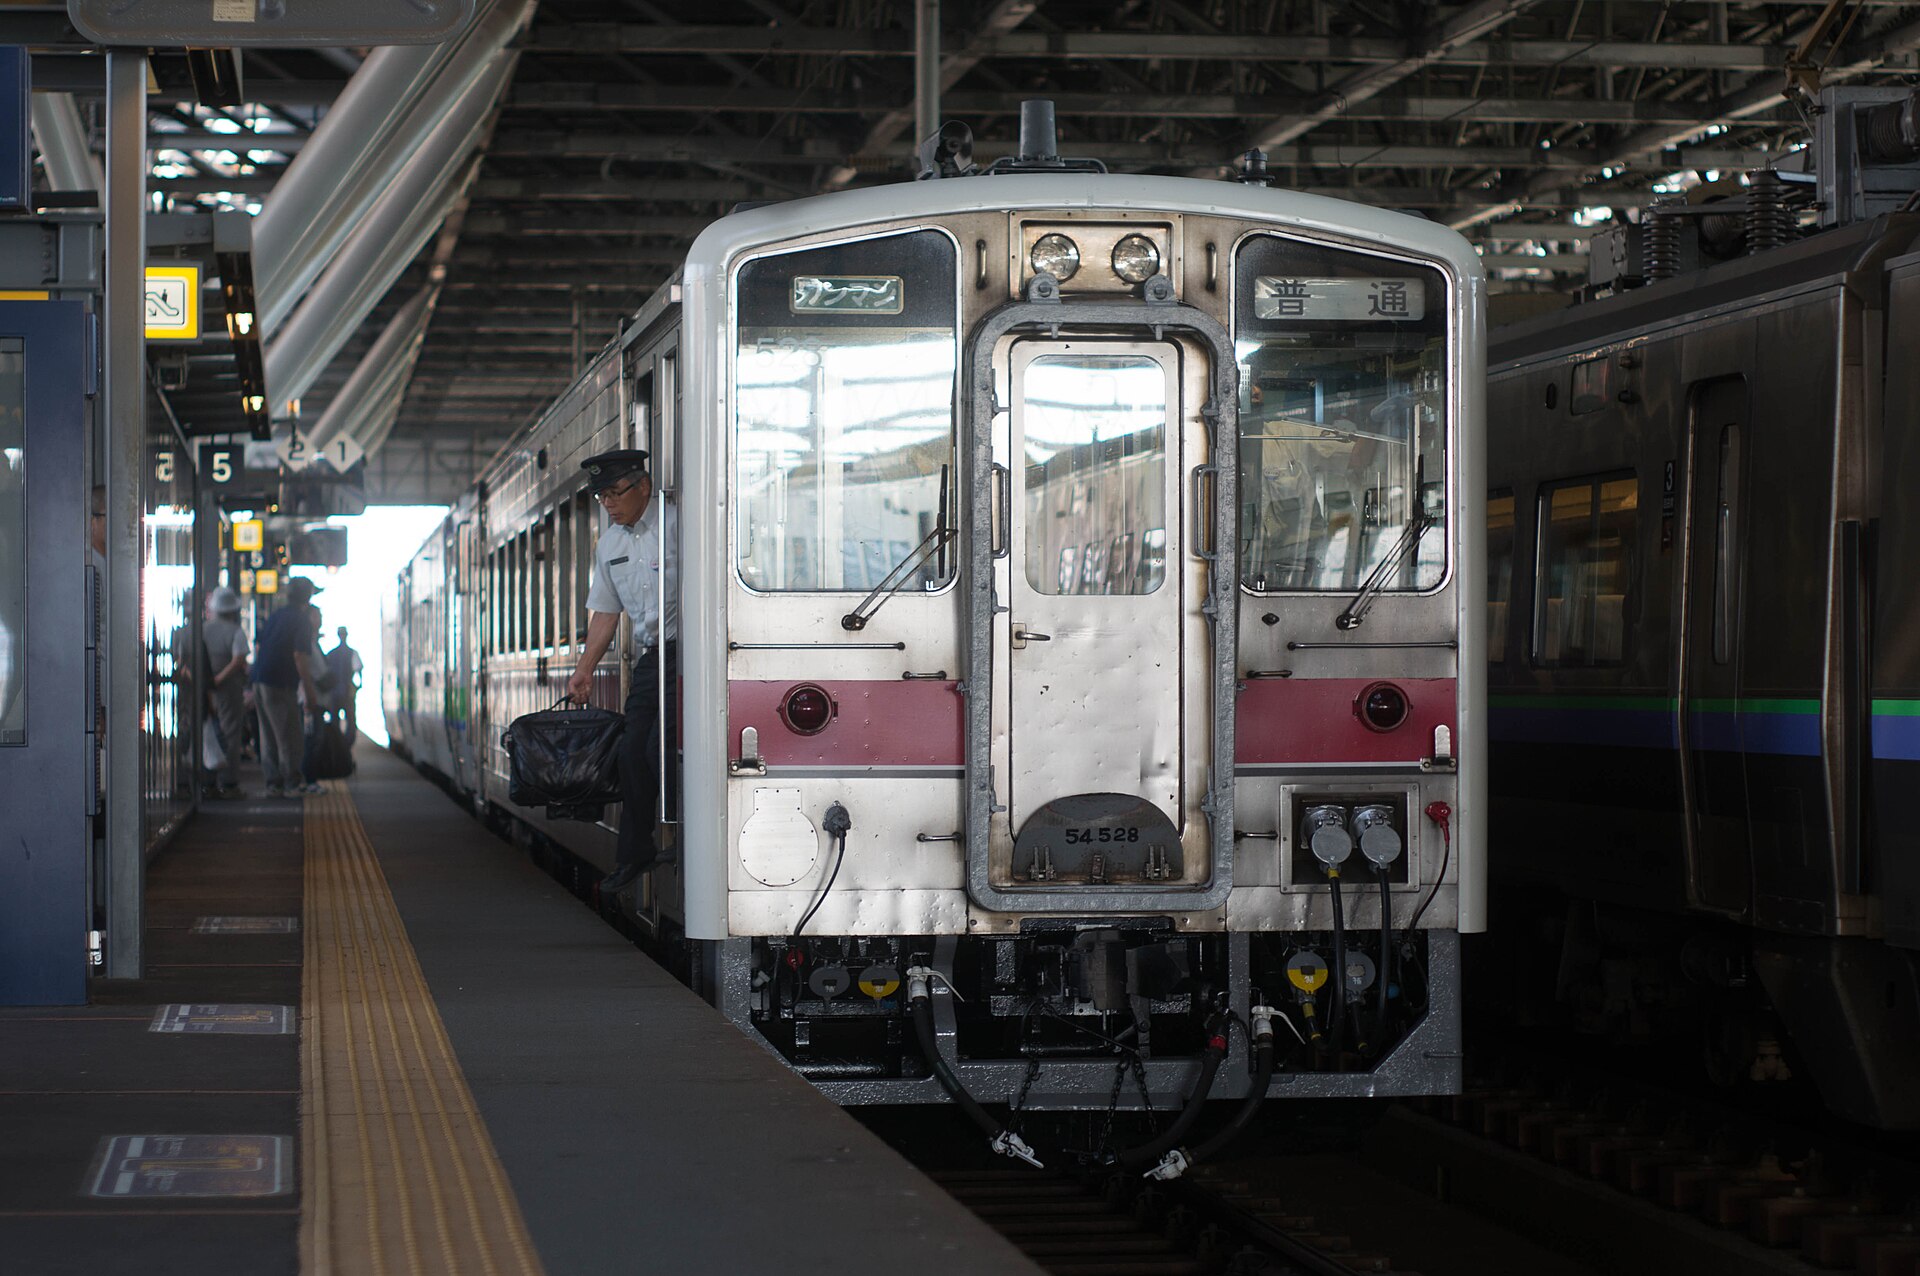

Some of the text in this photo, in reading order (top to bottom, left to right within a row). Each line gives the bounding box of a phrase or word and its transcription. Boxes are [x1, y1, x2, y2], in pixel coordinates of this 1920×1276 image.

[1270, 280, 1410, 317] 普通
[212, 452, 232, 482] 5
[1666, 462, 1673, 491] 3
